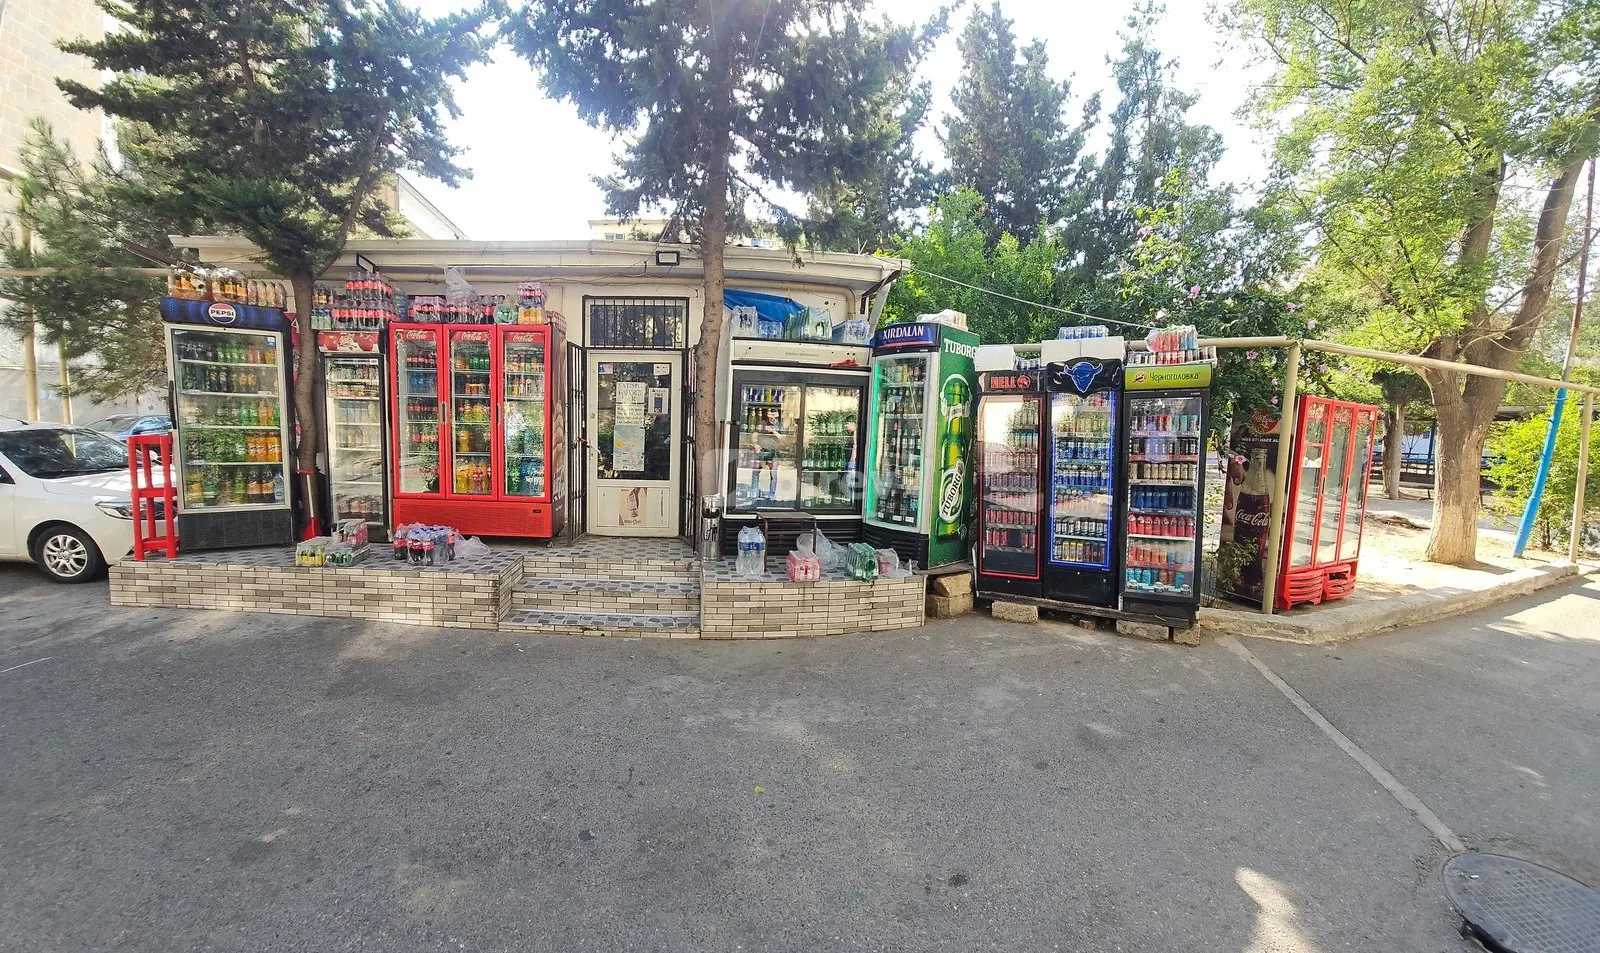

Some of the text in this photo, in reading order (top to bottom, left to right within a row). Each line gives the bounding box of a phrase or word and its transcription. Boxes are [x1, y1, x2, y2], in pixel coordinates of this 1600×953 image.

[210, 309, 234, 317] PEPSI
[882, 325, 924, 340] XIRDALAN
[990, 376, 1017, 389] HELL
[1149, 371, 1199, 383] Черноголовка
[942, 474, 962, 516] TUBORG
